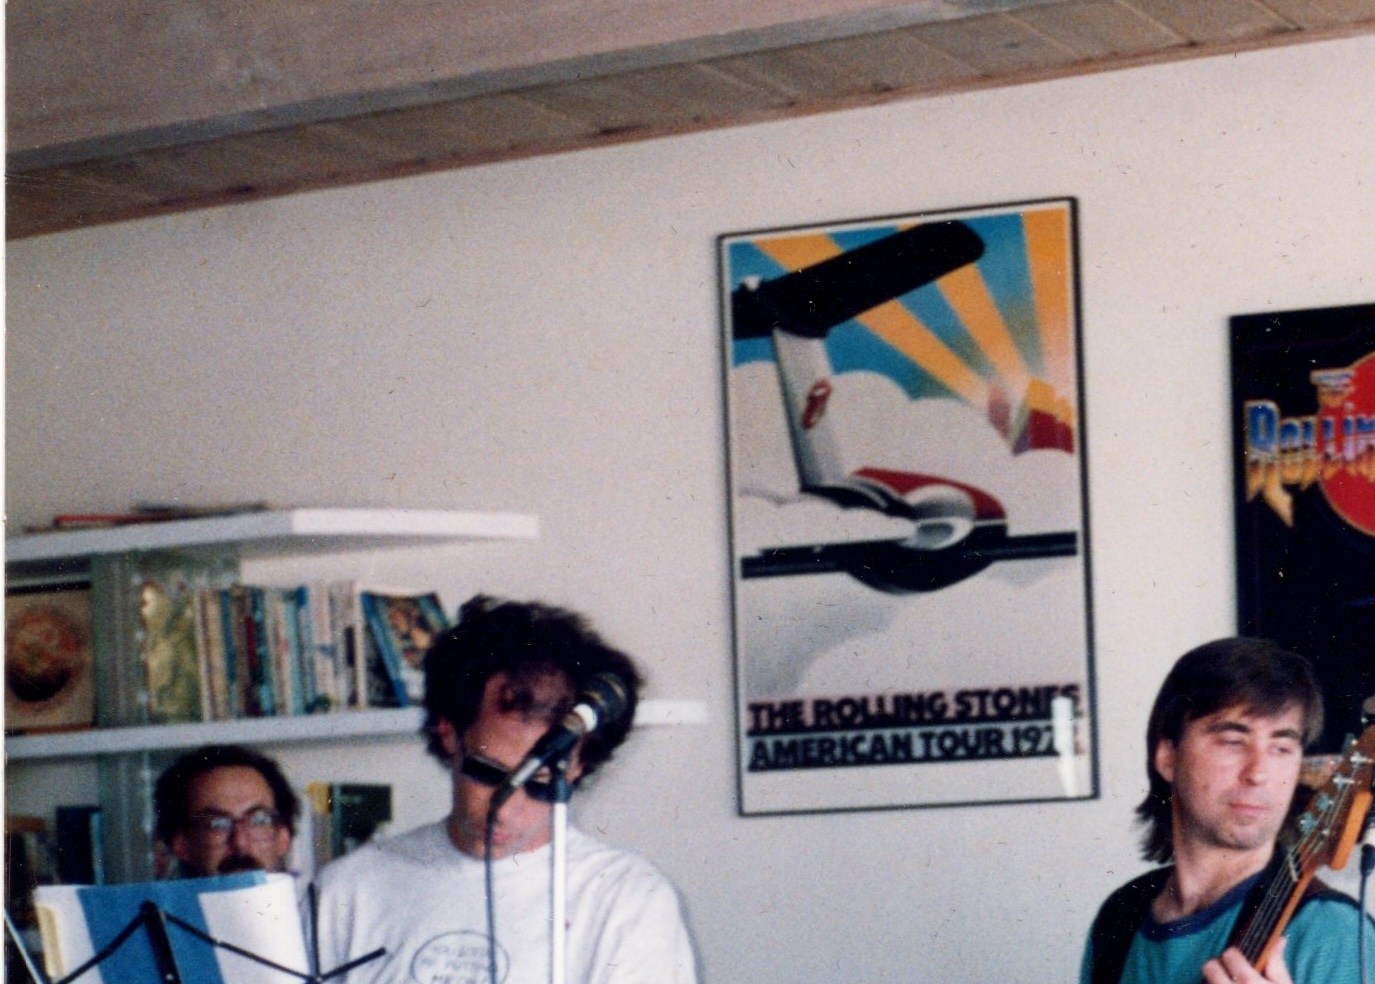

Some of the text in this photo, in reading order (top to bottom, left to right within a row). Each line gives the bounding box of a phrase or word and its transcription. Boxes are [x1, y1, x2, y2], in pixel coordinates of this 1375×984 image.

[748, 701, 803, 732] THE
[813, 693, 948, 728] ROLLING
[750, 723, 1082, 771] AMERICAN TOUR 197
